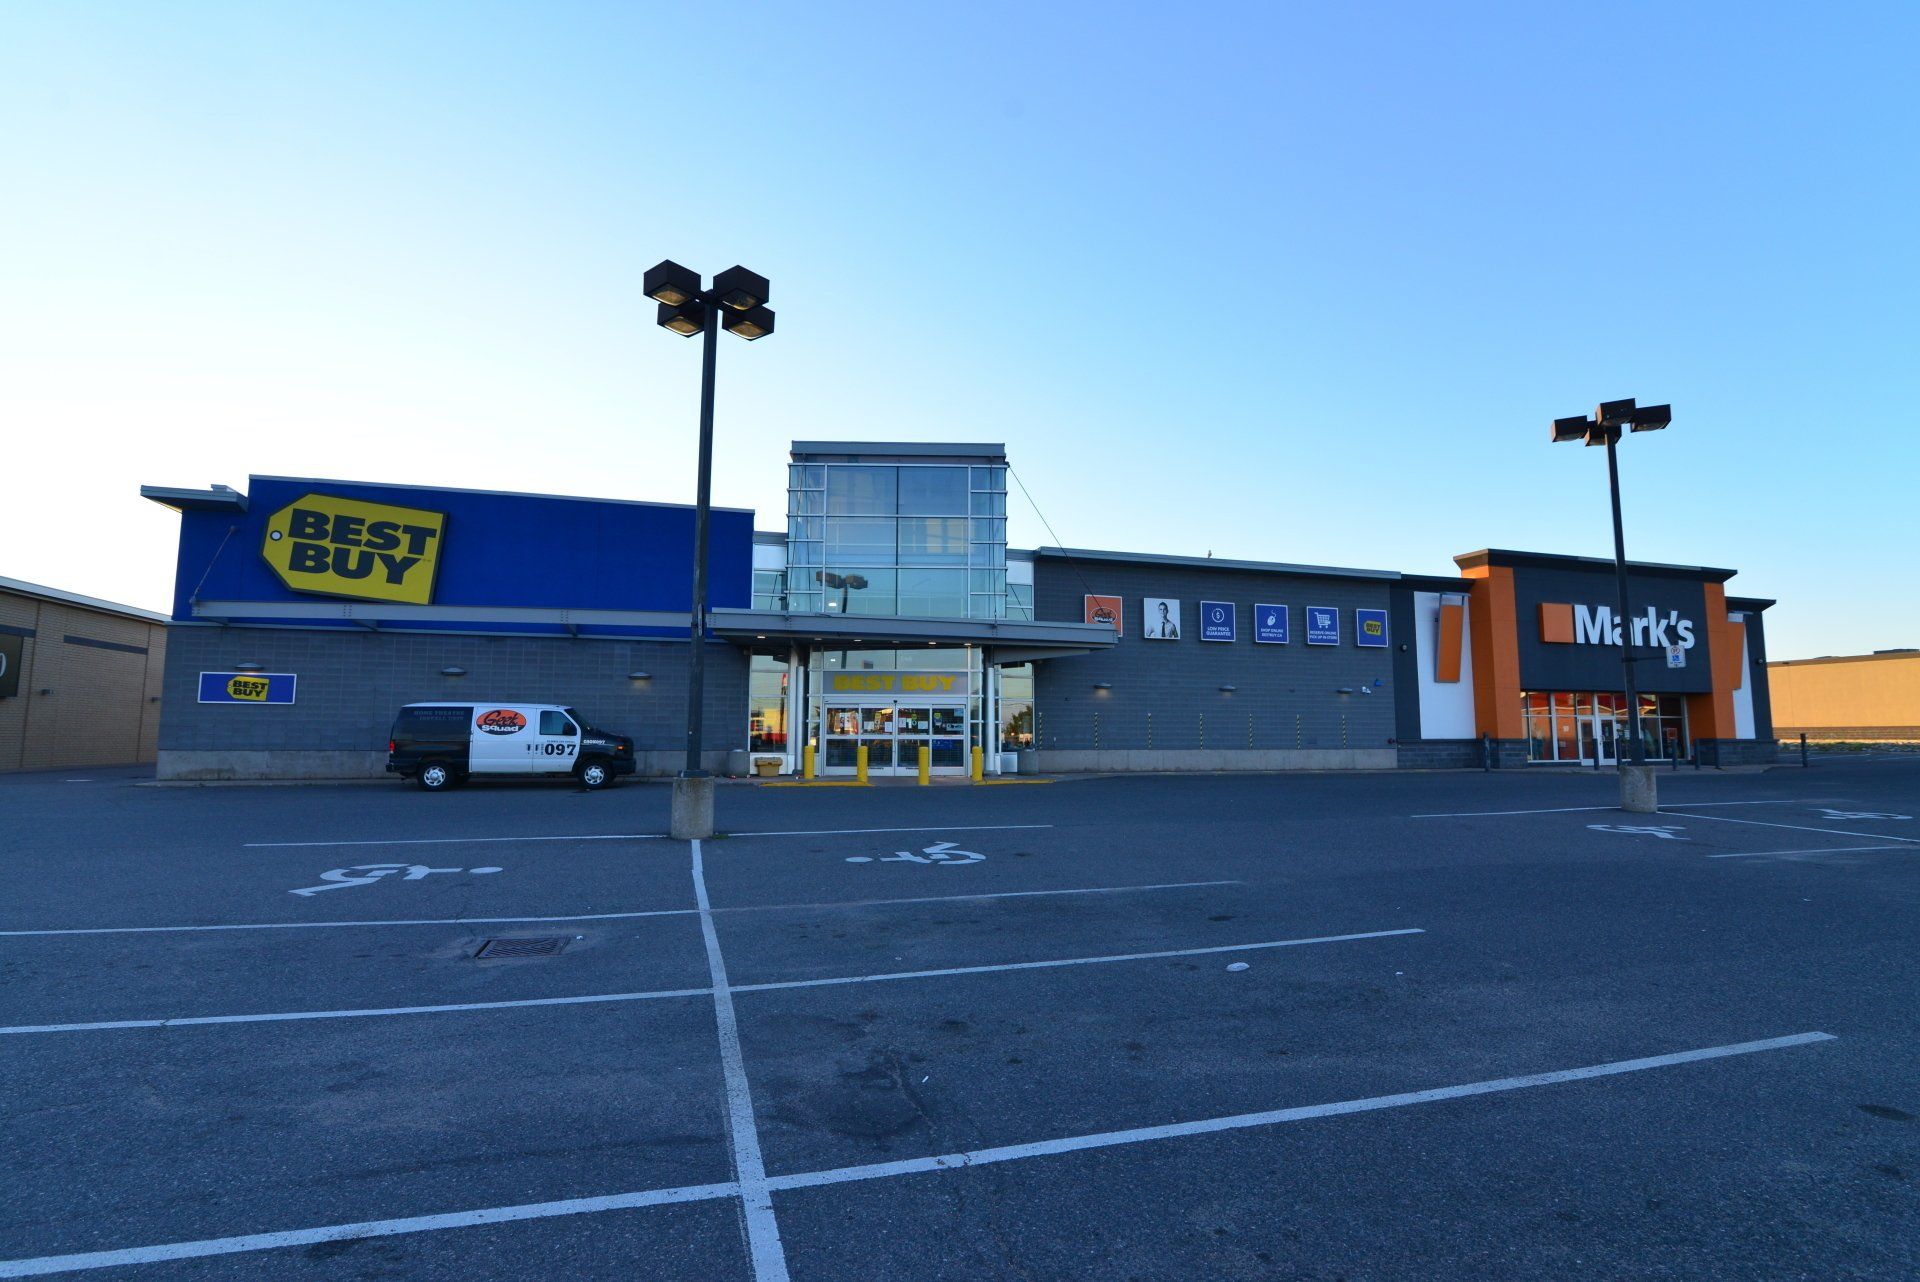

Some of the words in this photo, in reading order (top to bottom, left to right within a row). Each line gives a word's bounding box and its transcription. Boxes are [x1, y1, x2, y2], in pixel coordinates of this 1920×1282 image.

[288, 508, 437, 556] BEST
[288, 541, 421, 585] BUY
[1574, 604, 1695, 649] Mark's
[233, 680, 267, 690] BEST
[833, 675, 896, 691] BEST
[902, 675, 956, 691] BUY
[233, 687, 263, 697] BUY
[483, 710, 518, 726] Geek
[545, 743, 576, 756] 097
